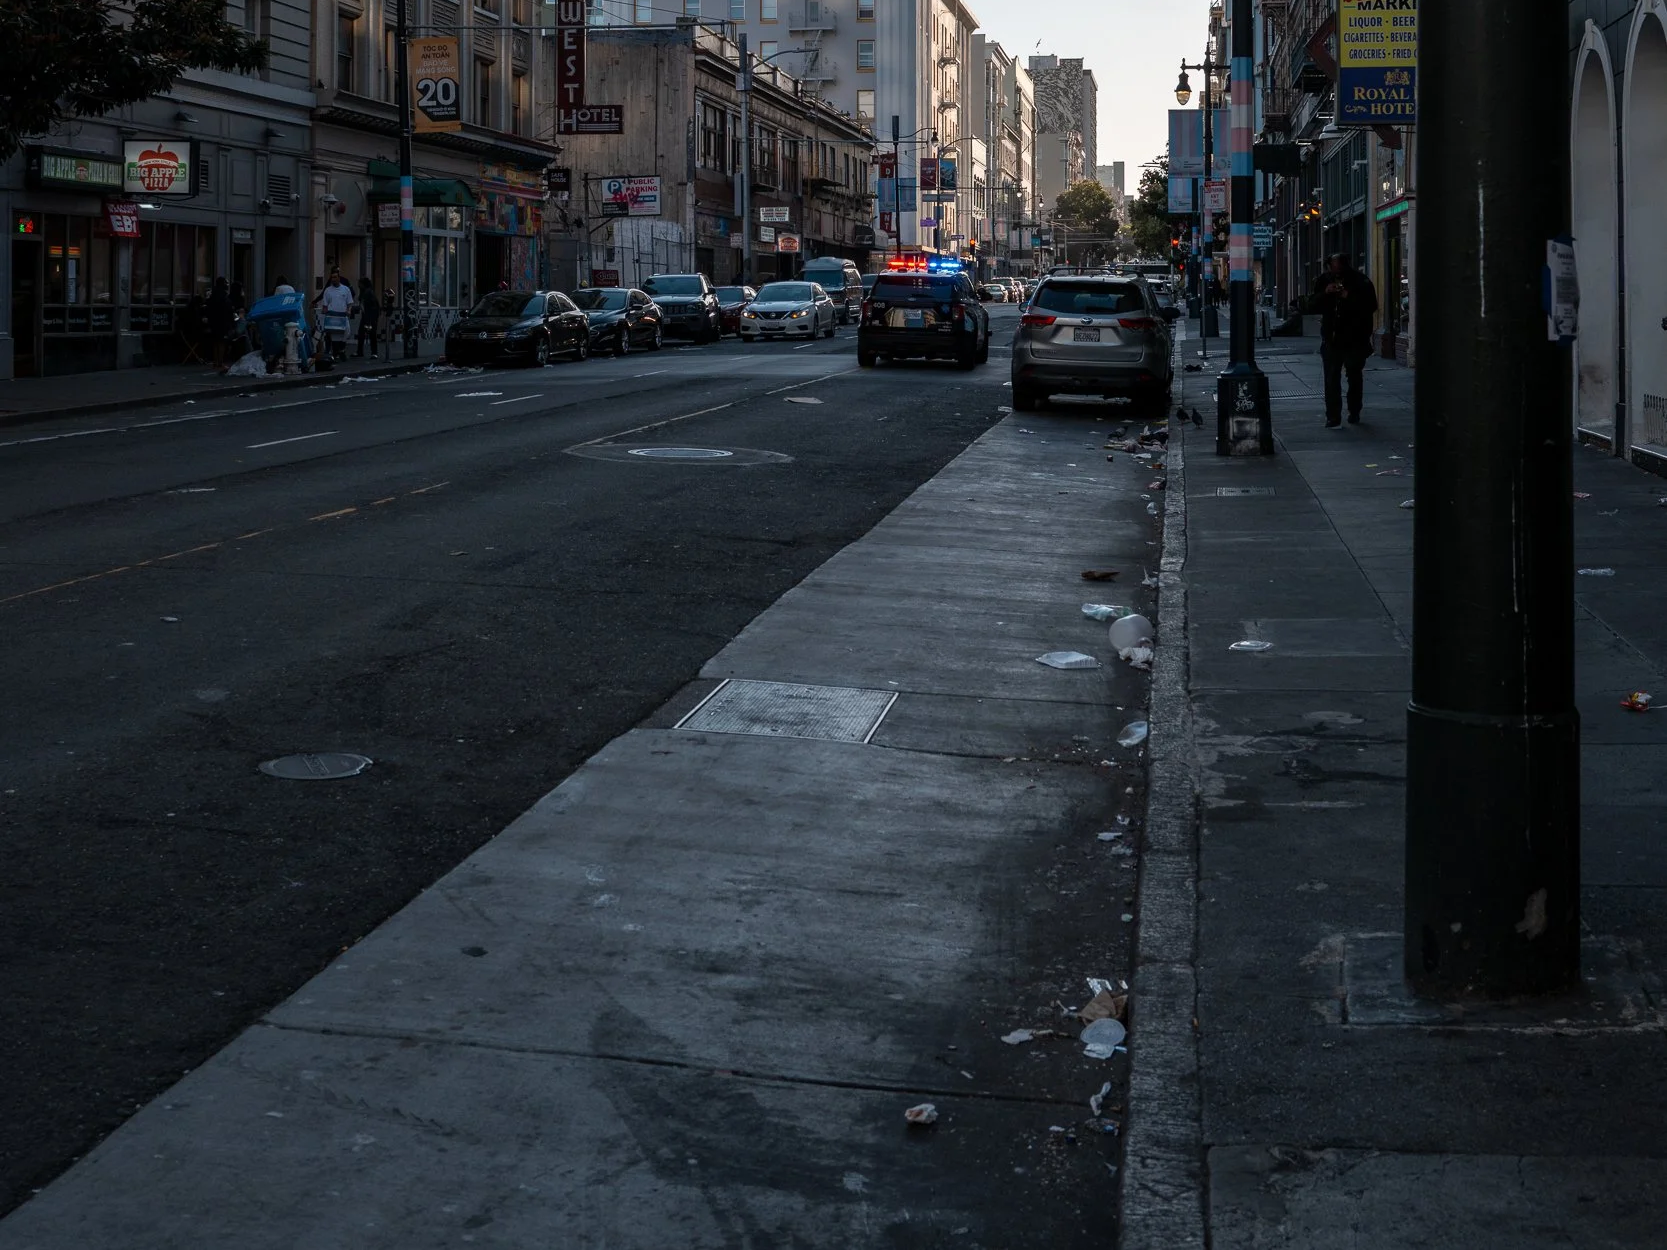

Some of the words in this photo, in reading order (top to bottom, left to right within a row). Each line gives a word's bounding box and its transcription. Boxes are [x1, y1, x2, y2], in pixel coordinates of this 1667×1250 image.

[1349, 16, 1382, 29] LIQUOR
[1392, 16, 1416, 27] BEER
[1344, 32, 1384, 42] CIGARETTES
[560, 1, 581, 103] WEST
[1349, 48, 1386, 59] GROCERIES
[1392, 48, 1411, 58] FRIED
[417, 77, 456, 107] 20
[1353, 86, 1410, 100] ROYAL
[1370, 102, 1415, 115] HOTE
[559, 109, 620, 132] HOTEL
[129, 167, 149, 177] BIG
[150, 167, 186, 178] APPLE
[144, 178, 169, 188] PIZZA
[625, 185, 658, 193] PARKING
[110, 215, 138, 233] EBT
